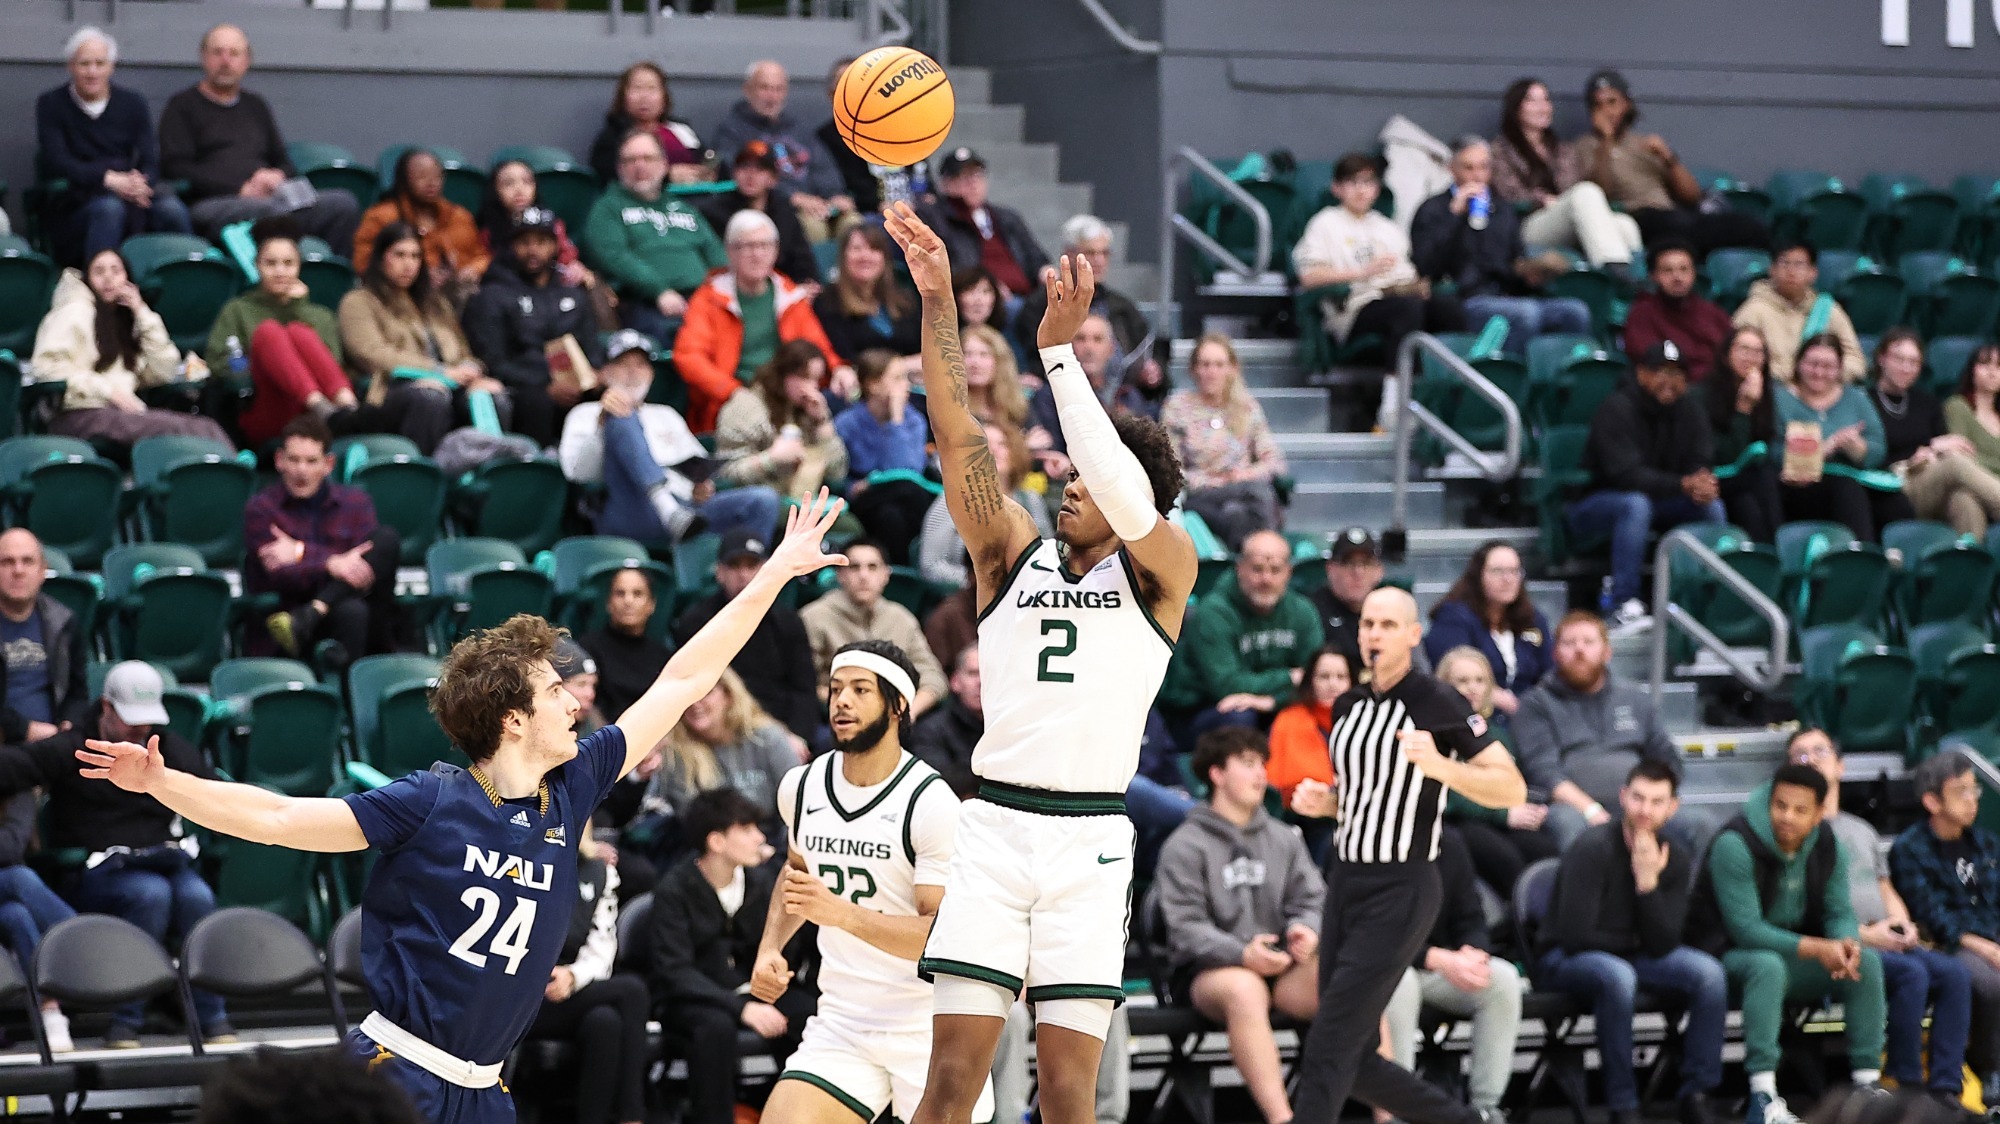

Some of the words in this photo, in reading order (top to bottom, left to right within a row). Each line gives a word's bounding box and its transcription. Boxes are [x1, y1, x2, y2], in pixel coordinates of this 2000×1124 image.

[878, 58, 941, 98] Wilson
[1037, 618, 1078, 683] 2
[462, 843, 554, 892] NAU
[805, 834, 892, 860] VIKINGS
[448, 886, 538, 976] 24
